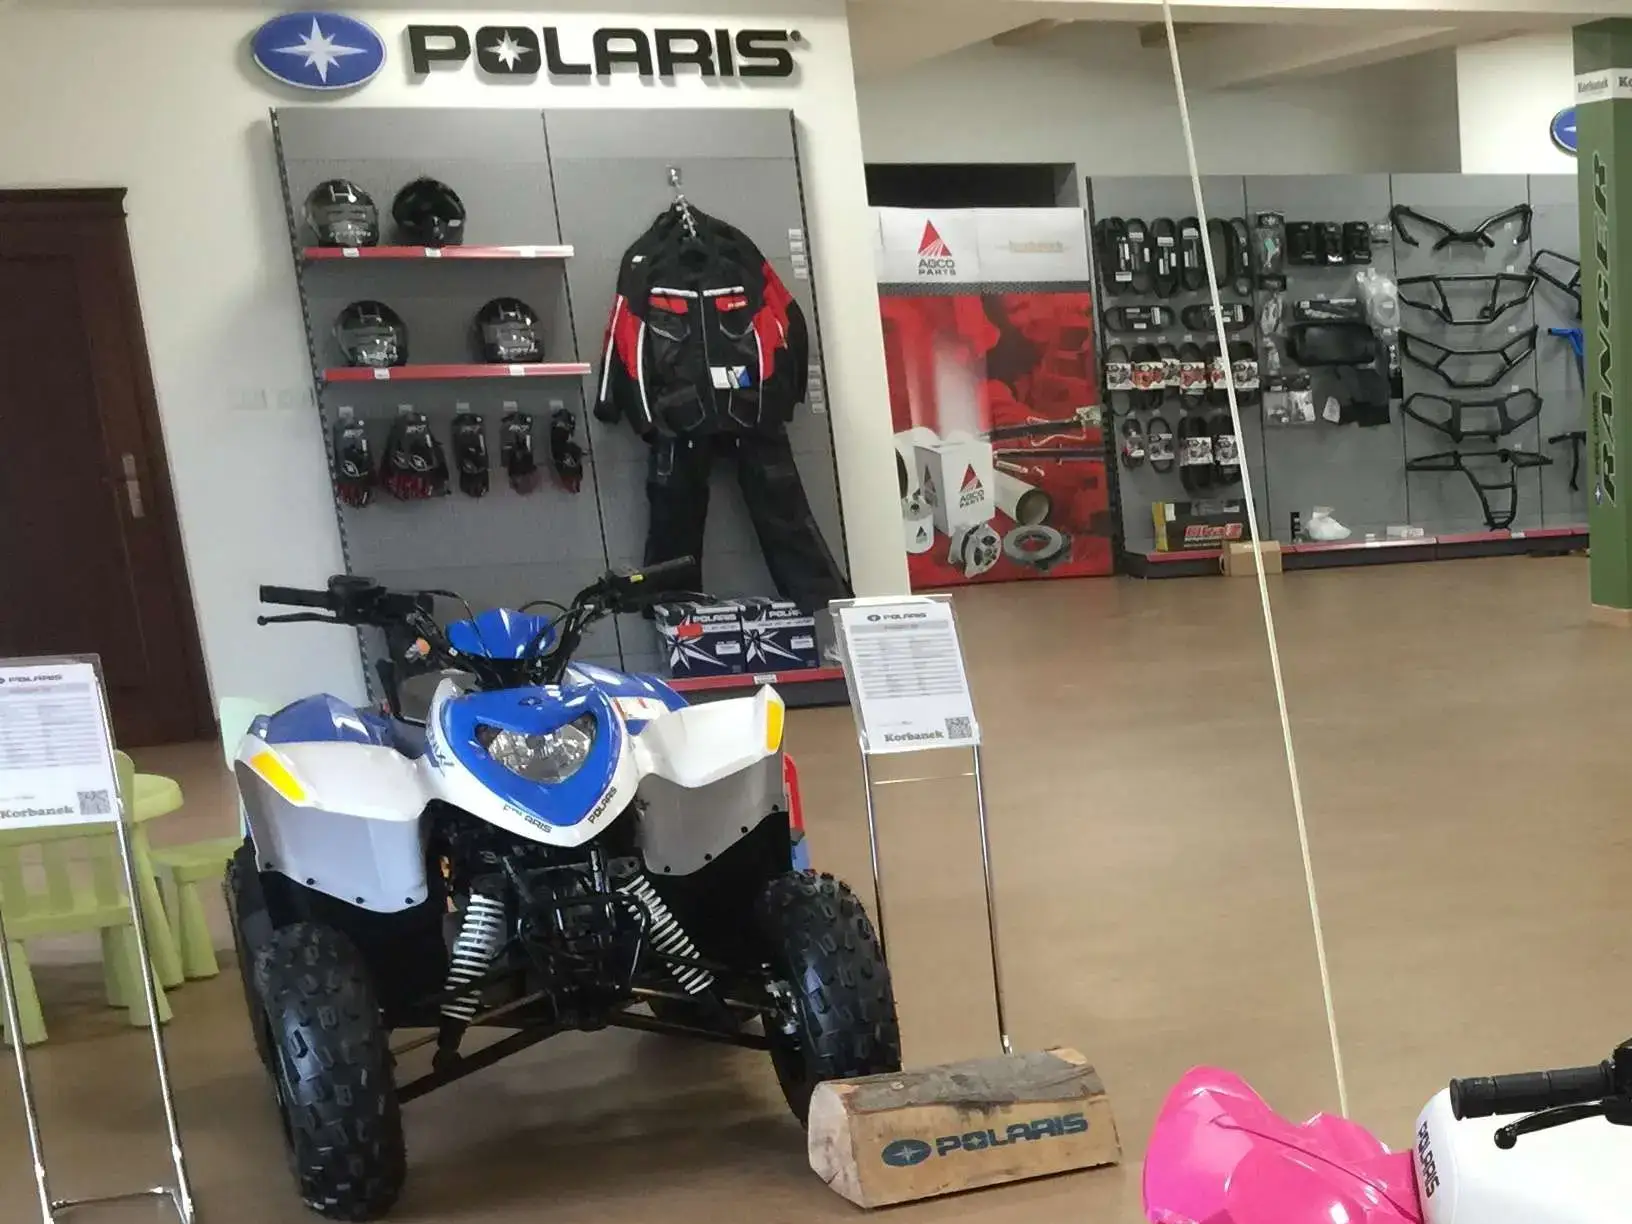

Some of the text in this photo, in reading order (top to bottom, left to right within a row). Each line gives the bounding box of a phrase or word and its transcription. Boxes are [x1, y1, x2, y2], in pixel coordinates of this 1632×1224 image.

[407, 25, 795, 77] POLARIS
[918, 258, 956, 269] AGCO
[918, 268, 956, 276] PARTS
[1593, 150, 1616, 507] RANGER
[883, 730, 945, 743] Korbanek
[0, 805, 75, 819] Korbanek
[587, 786, 618, 824] POLARIS
[935, 1112, 1089, 1157] POLARIS
[1417, 1120, 1440, 1198] POLARIS
